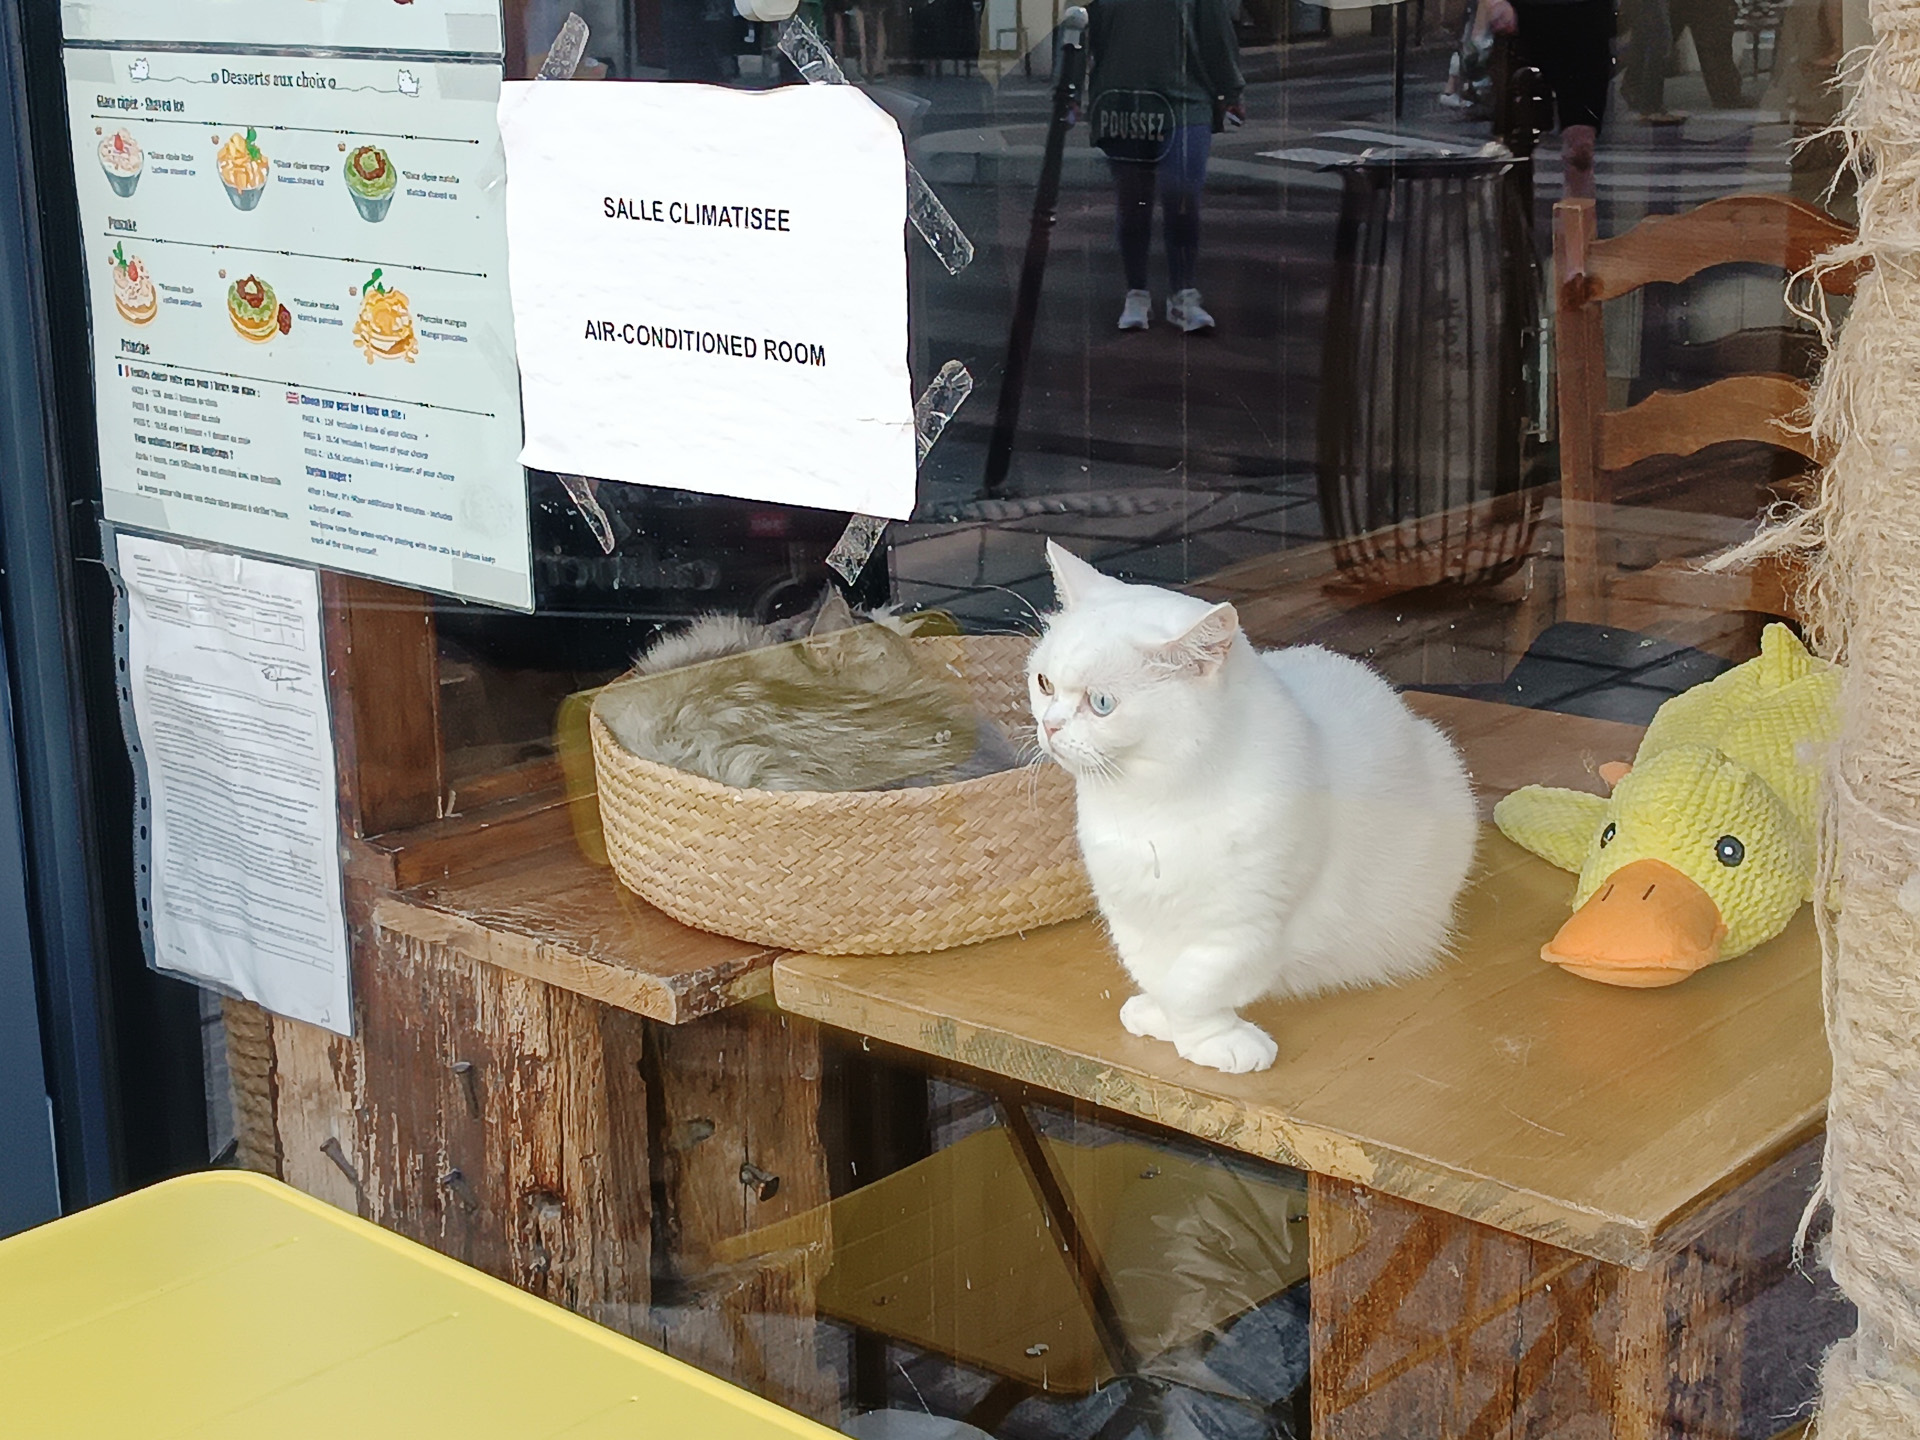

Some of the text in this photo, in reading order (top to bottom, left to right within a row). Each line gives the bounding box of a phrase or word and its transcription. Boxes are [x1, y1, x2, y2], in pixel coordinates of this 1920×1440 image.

[221, 68, 327, 89] Desserts aux choix
[1100, 110, 1164, 142] POUSSEZ
[604, 197, 790, 232] SALLE CLIMATISEE
[585, 319, 826, 367] AIR-CONDITIONED ROOM
